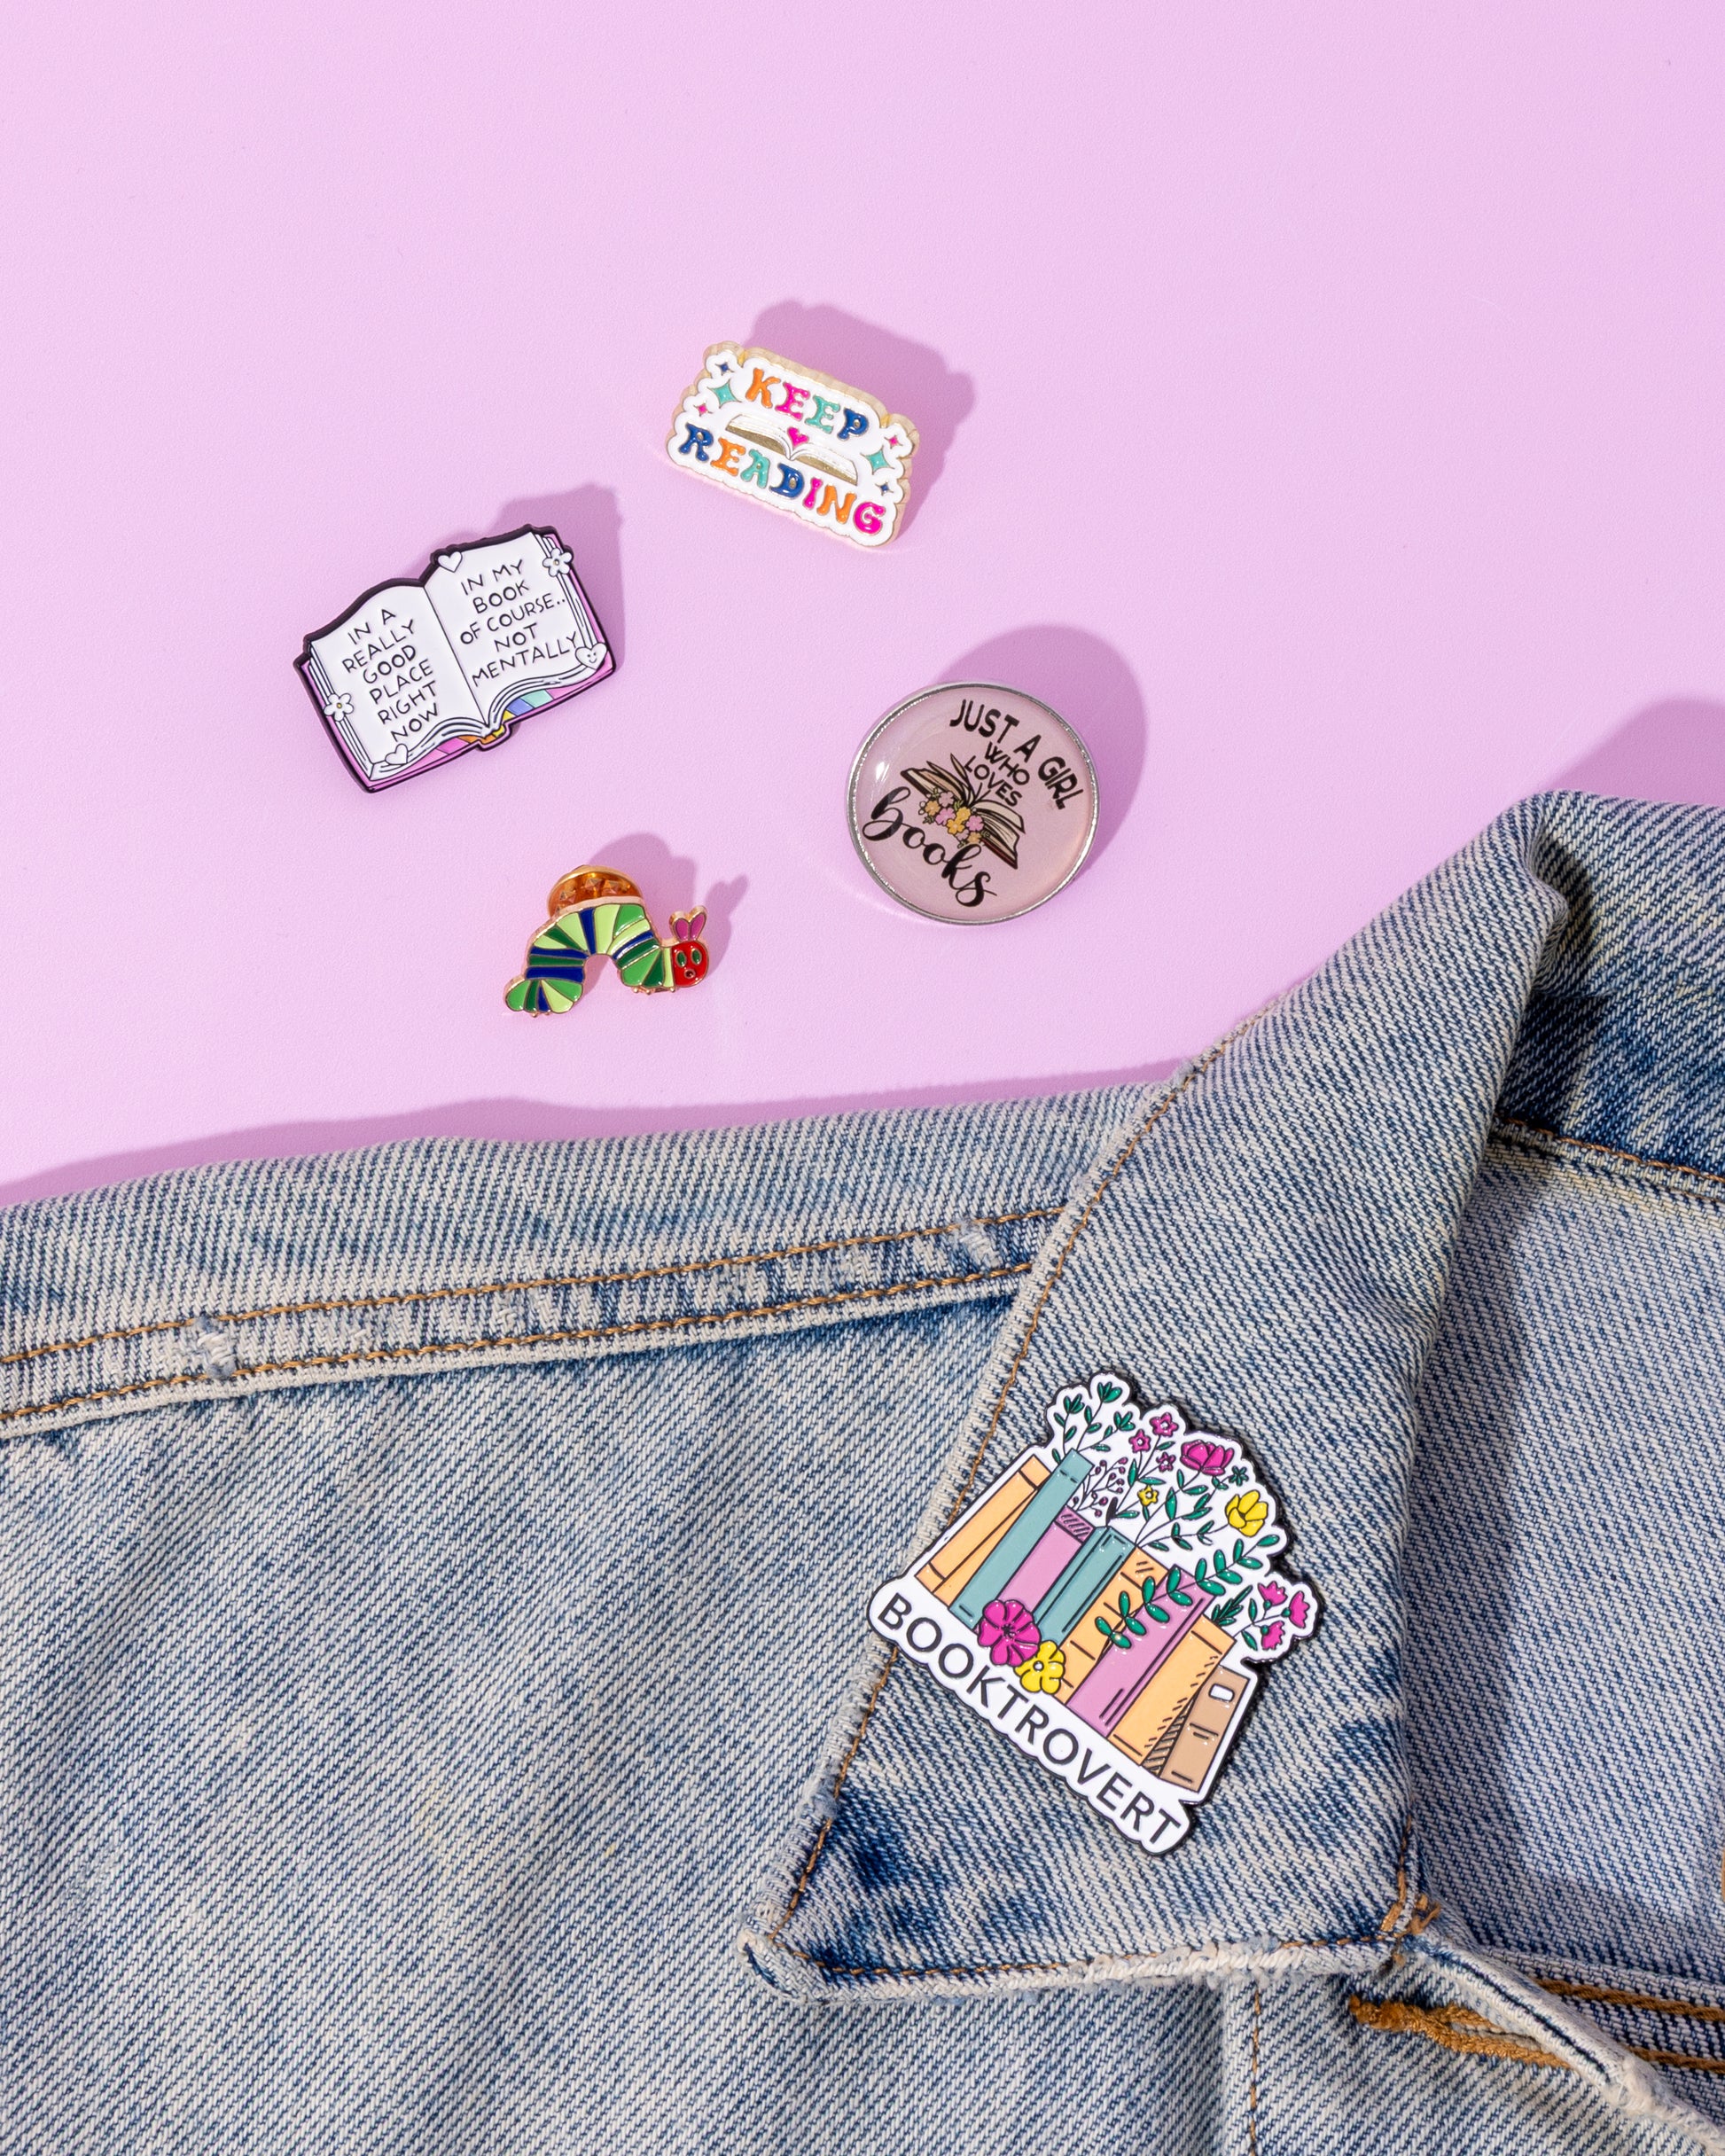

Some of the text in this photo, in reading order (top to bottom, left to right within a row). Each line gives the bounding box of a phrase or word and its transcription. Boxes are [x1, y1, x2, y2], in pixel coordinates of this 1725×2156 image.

[745, 368, 869, 440] KEEP
[678, 423, 886, 535] READING
[460, 559, 524, 595] IN MY
[472, 580, 529, 613] BOOK
[342, 619, 416, 674] REALLY
[347, 609, 395, 644] IN A
[460, 621, 481, 644] OF
[494, 622, 539, 652] NOT
[363, 644, 417, 684] GOOD
[472, 631, 579, 687] MENTALLY
[369, 659, 433, 705] PLACE
[378, 680, 439, 724] RIGHT
[391, 703, 439, 742] NOW
[949, 699, 1084, 810] JUST A GIRL
[984, 742, 1030, 785] WHO
[964, 755, 1023, 808] LOVES
[878, 1592, 1182, 1844] BOOKTROVERT
